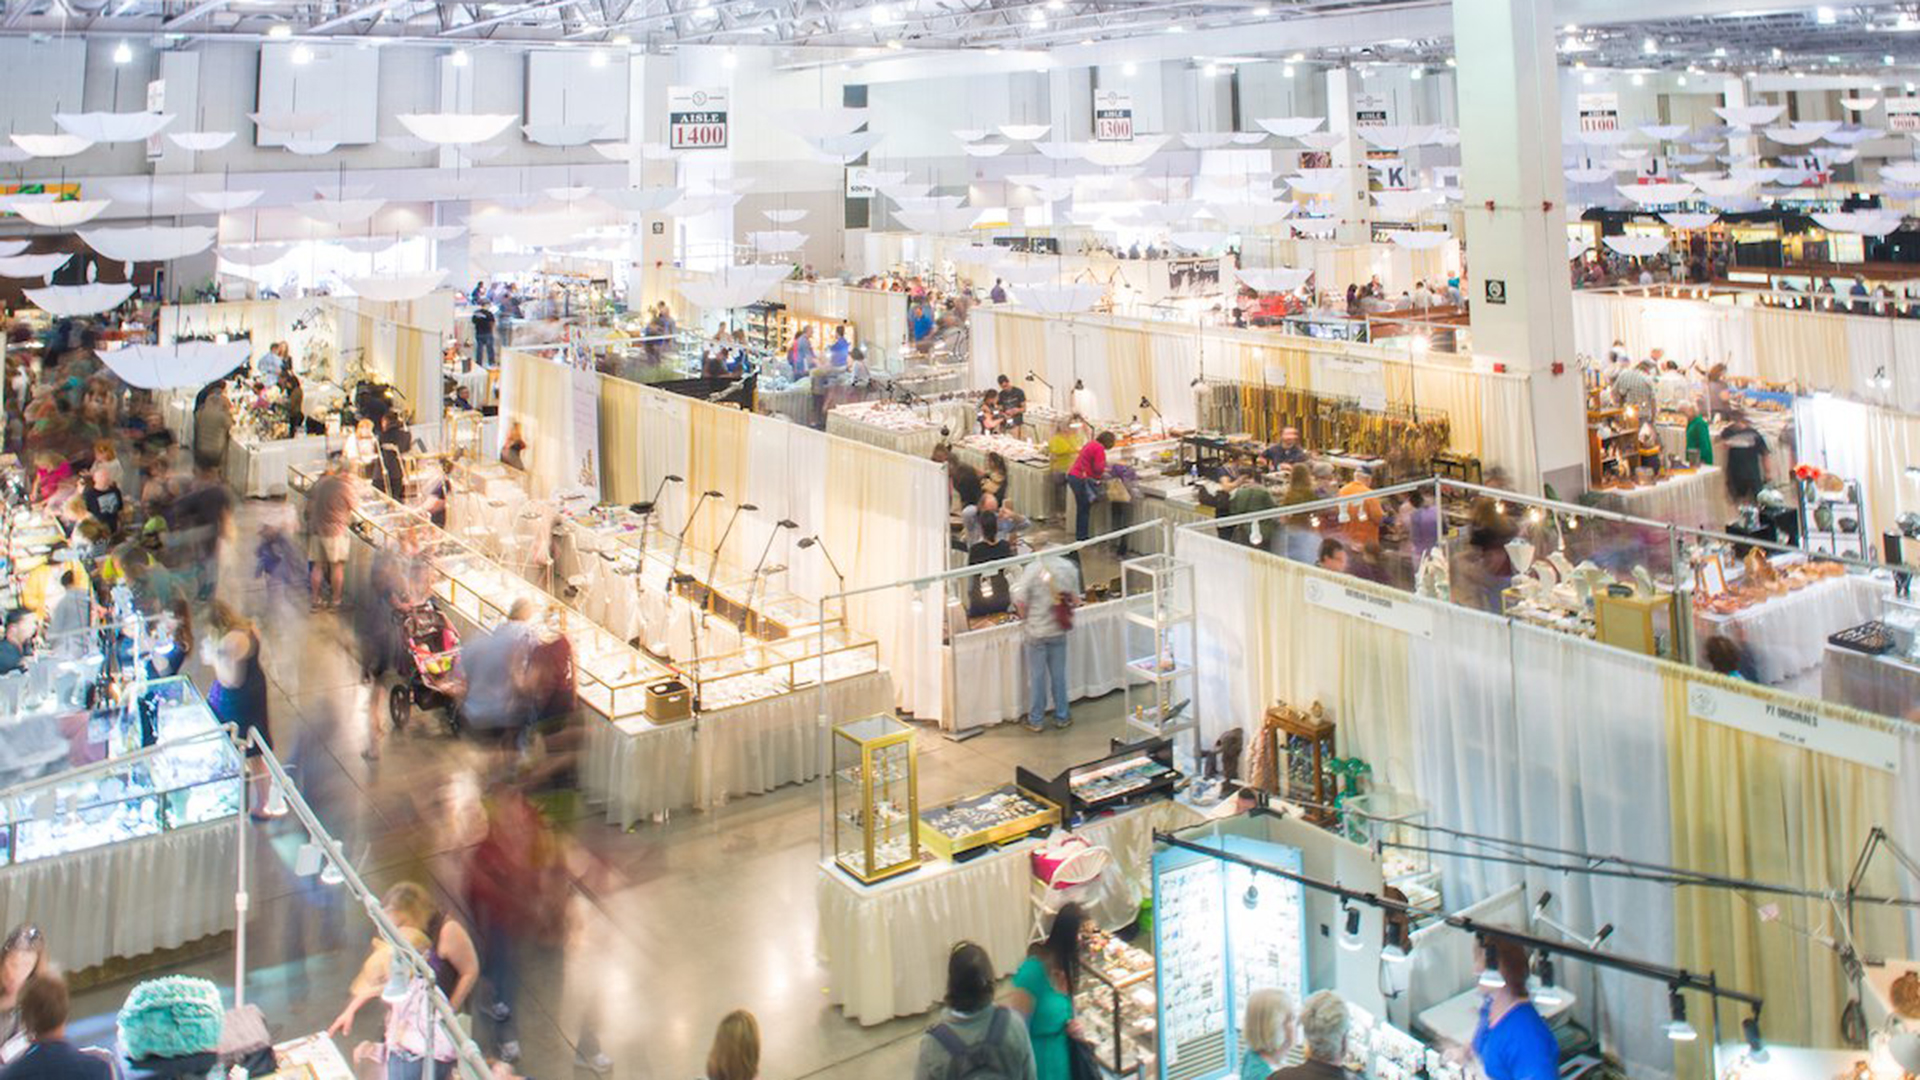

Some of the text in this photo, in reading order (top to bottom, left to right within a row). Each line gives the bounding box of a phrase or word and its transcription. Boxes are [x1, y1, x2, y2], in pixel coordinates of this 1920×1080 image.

[680, 113, 720, 123] AISLE
[1103, 110, 1124, 118] AISLE
[1099, 120, 1130, 138] 1300
[1584, 118, 1615, 131] 1100
[676, 126, 724, 145] 1400
[1645, 158, 1659, 176] J
[1387, 166, 1405, 187] K
